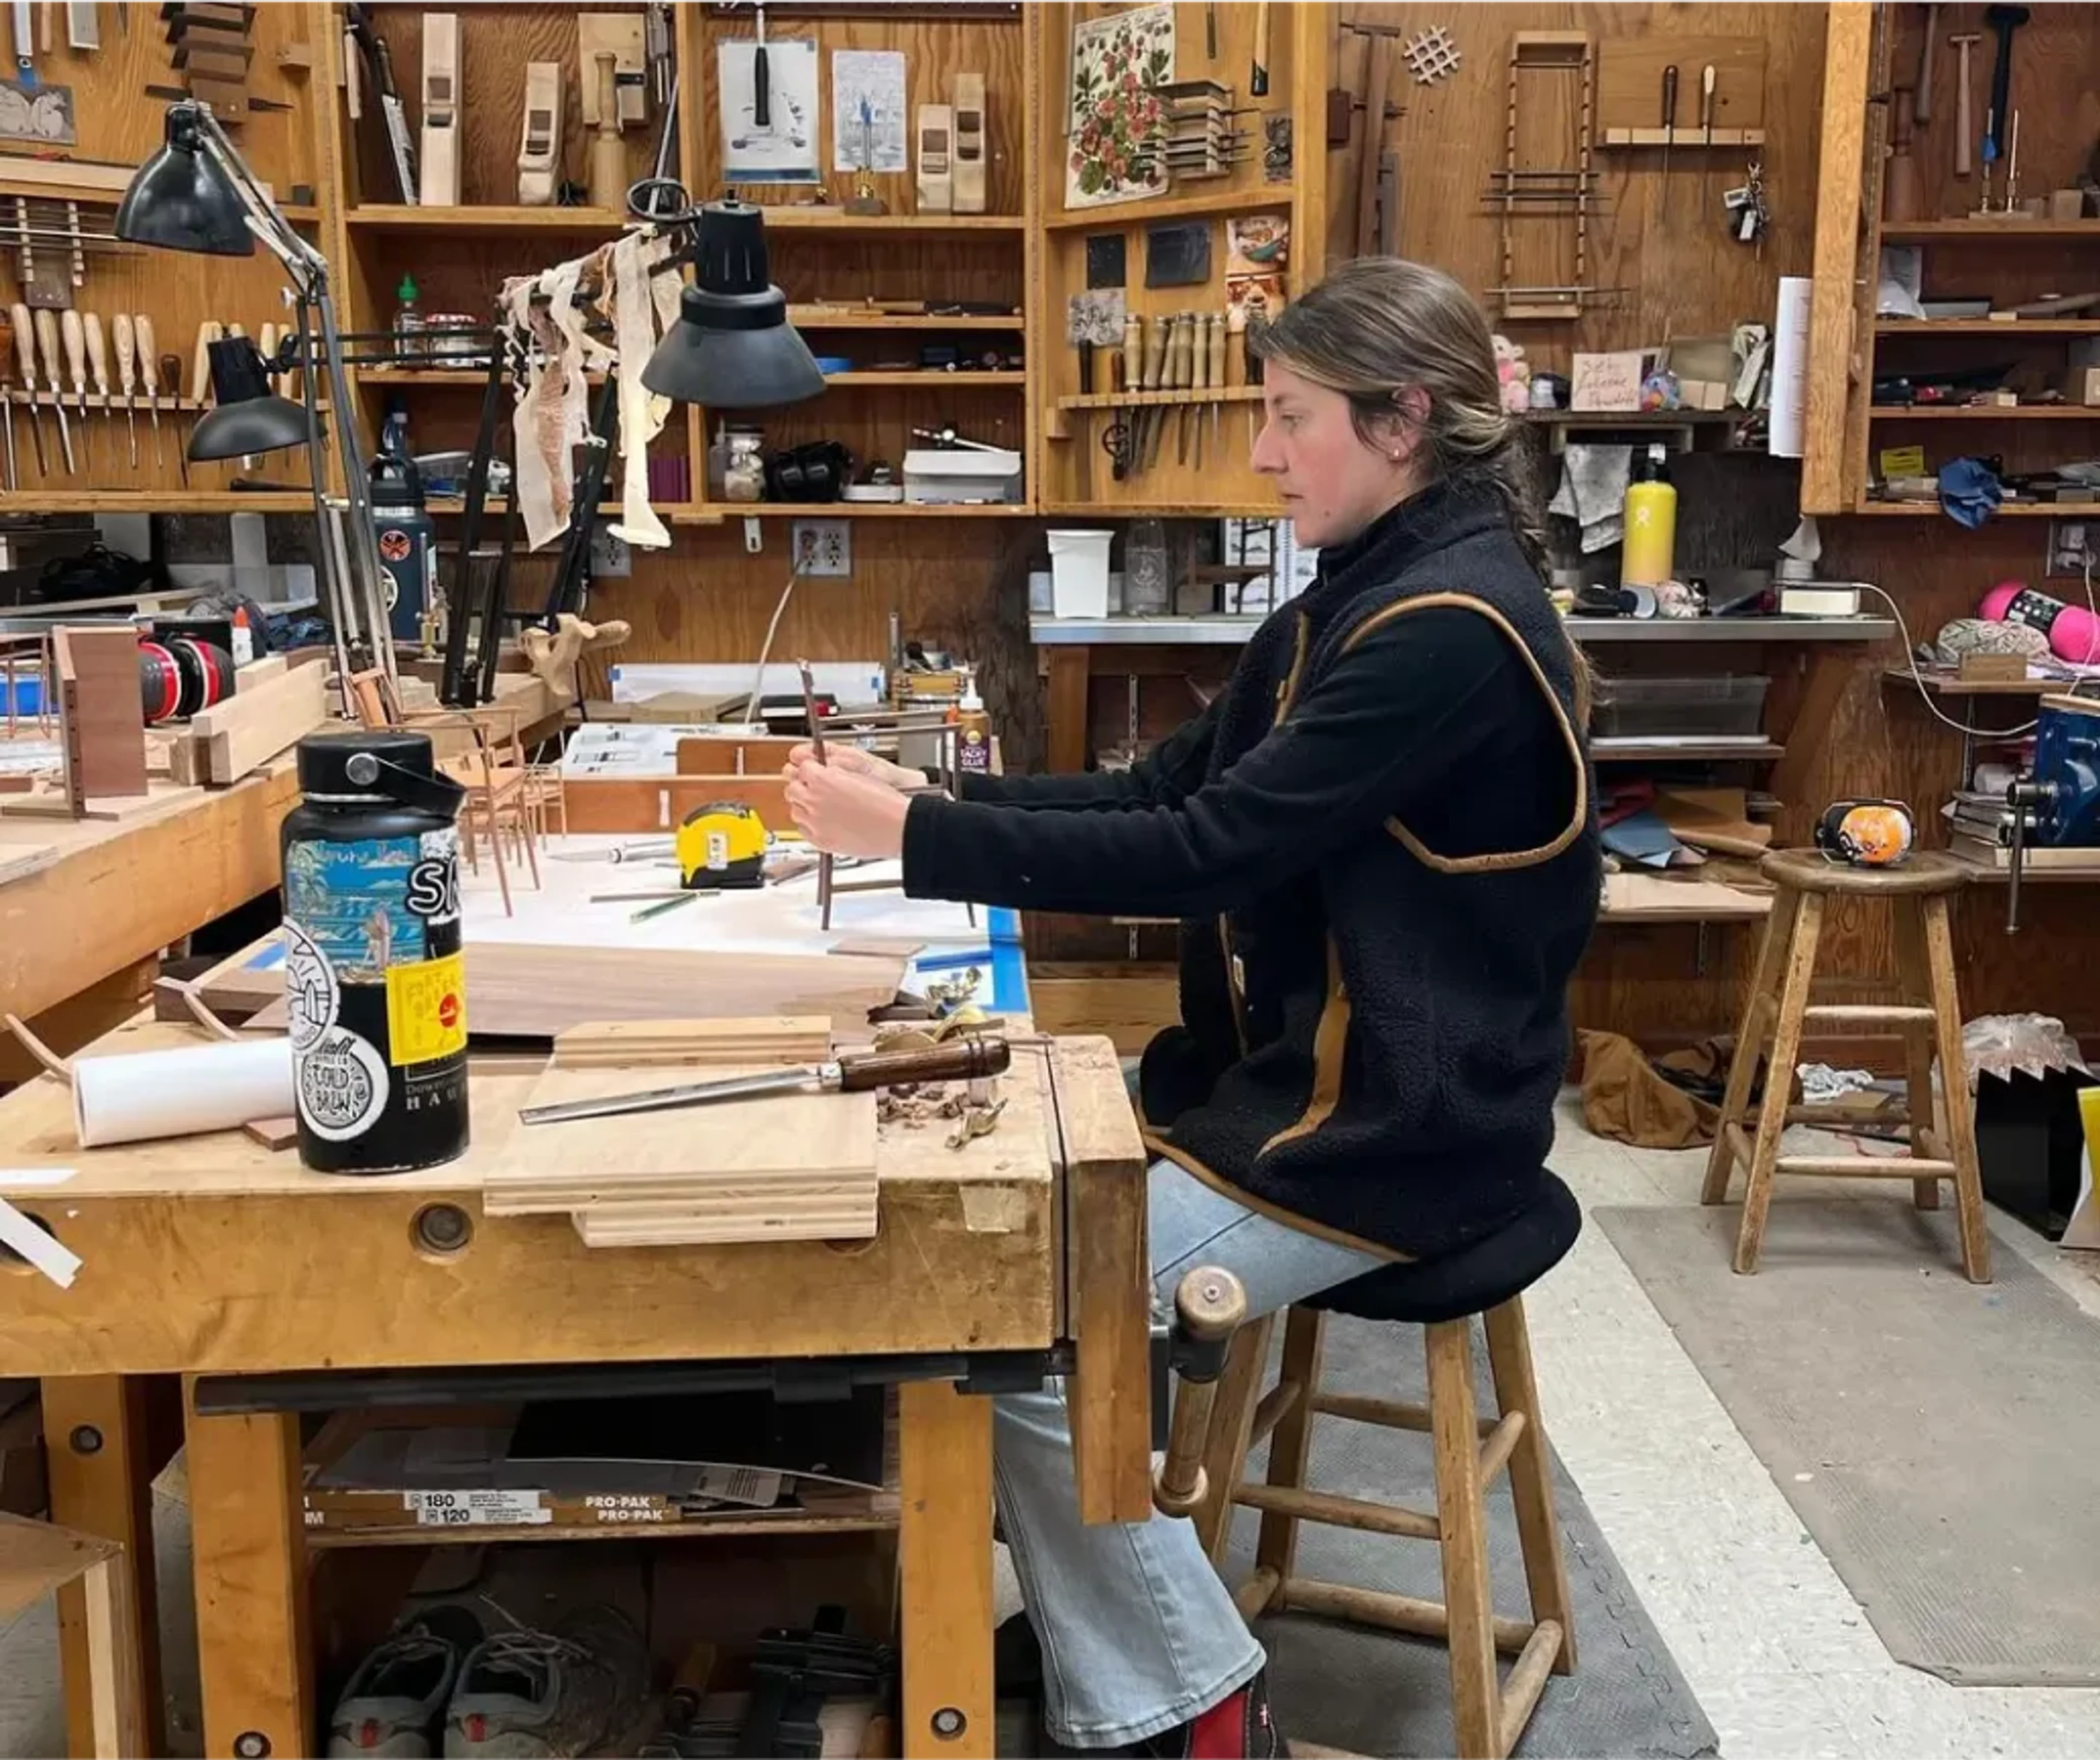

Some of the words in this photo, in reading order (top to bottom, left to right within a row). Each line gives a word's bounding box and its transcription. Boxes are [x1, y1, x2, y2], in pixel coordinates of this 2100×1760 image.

[313, 1063, 349, 1089] COLD
[425, 1494, 455, 1507] 180
[441, 1510, 470, 1523] 120
[598, 1509, 663, 1521] PRO-PAK
